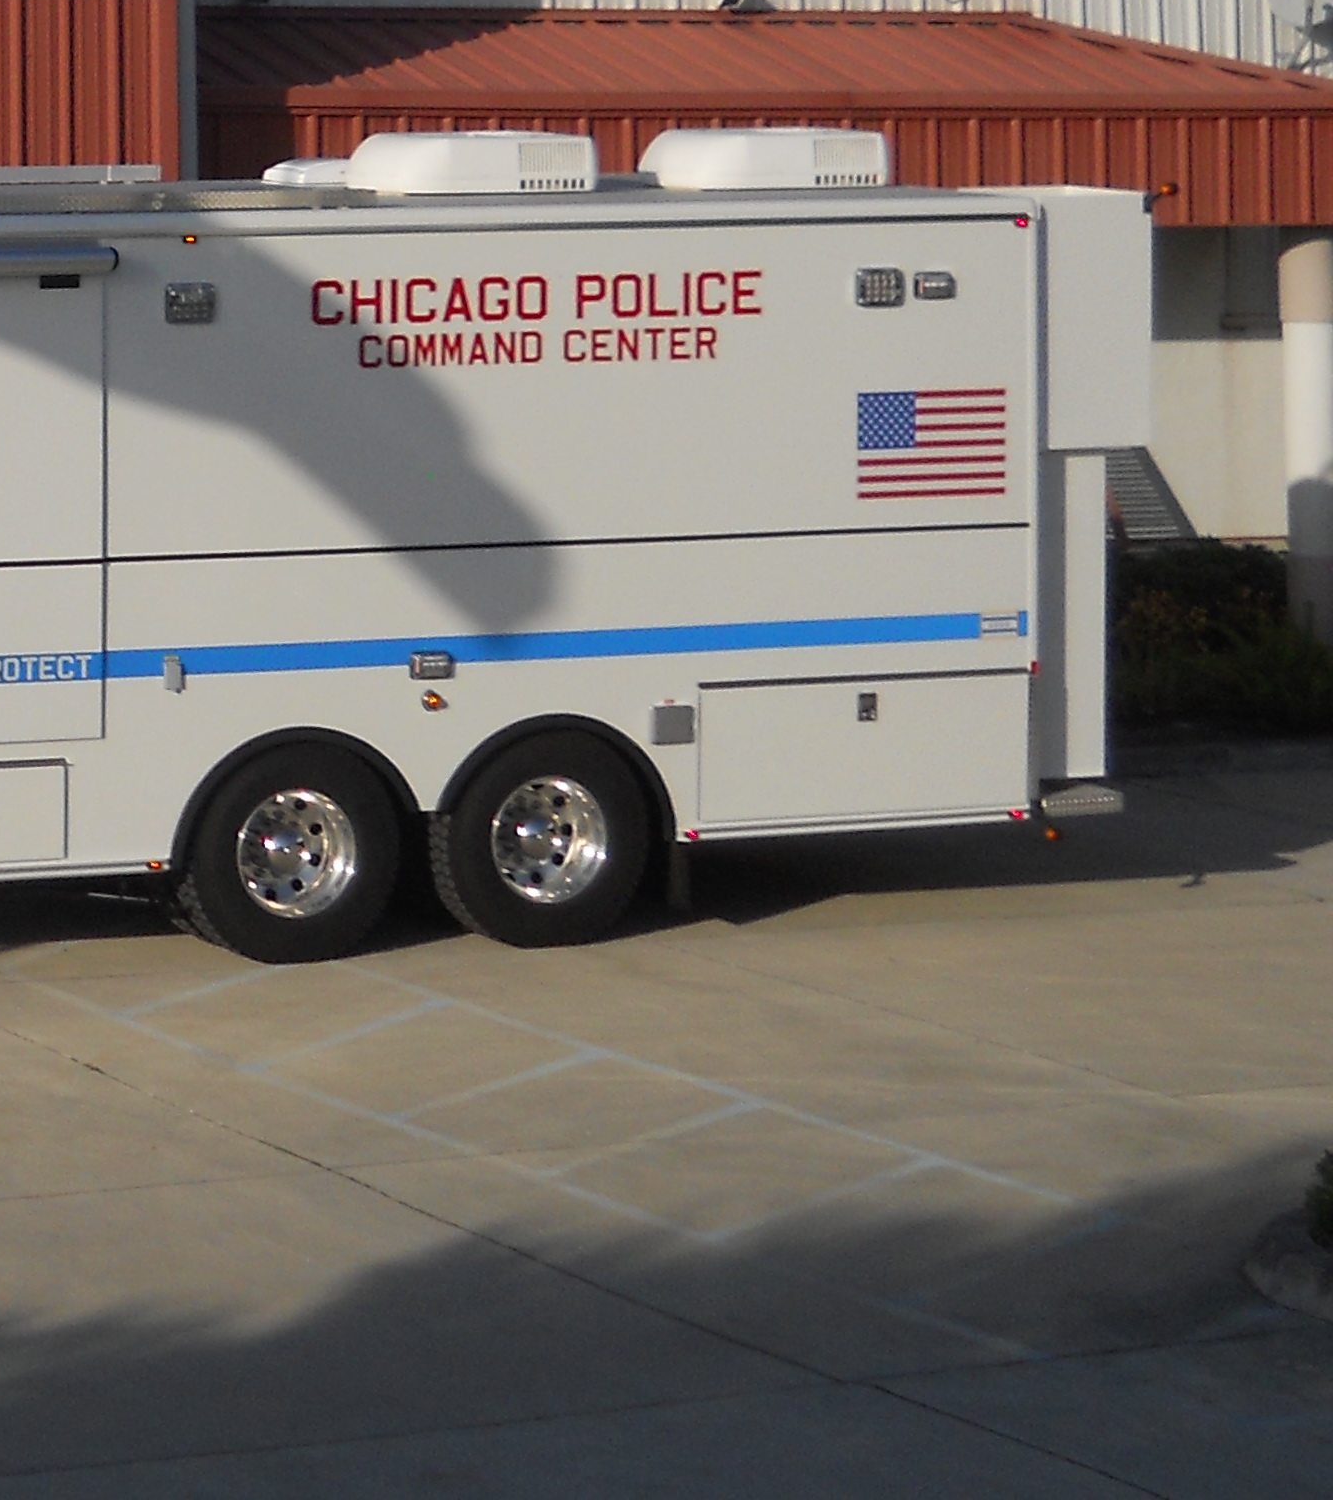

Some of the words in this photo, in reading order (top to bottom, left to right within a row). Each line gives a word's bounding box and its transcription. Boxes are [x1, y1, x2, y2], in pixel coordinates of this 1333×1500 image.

[310, 274, 549, 326] CHICAGO
[575, 269, 763, 319] POLICE
[358, 331, 544, 369] COMMAND
[563, 327, 718, 363] CENTER
